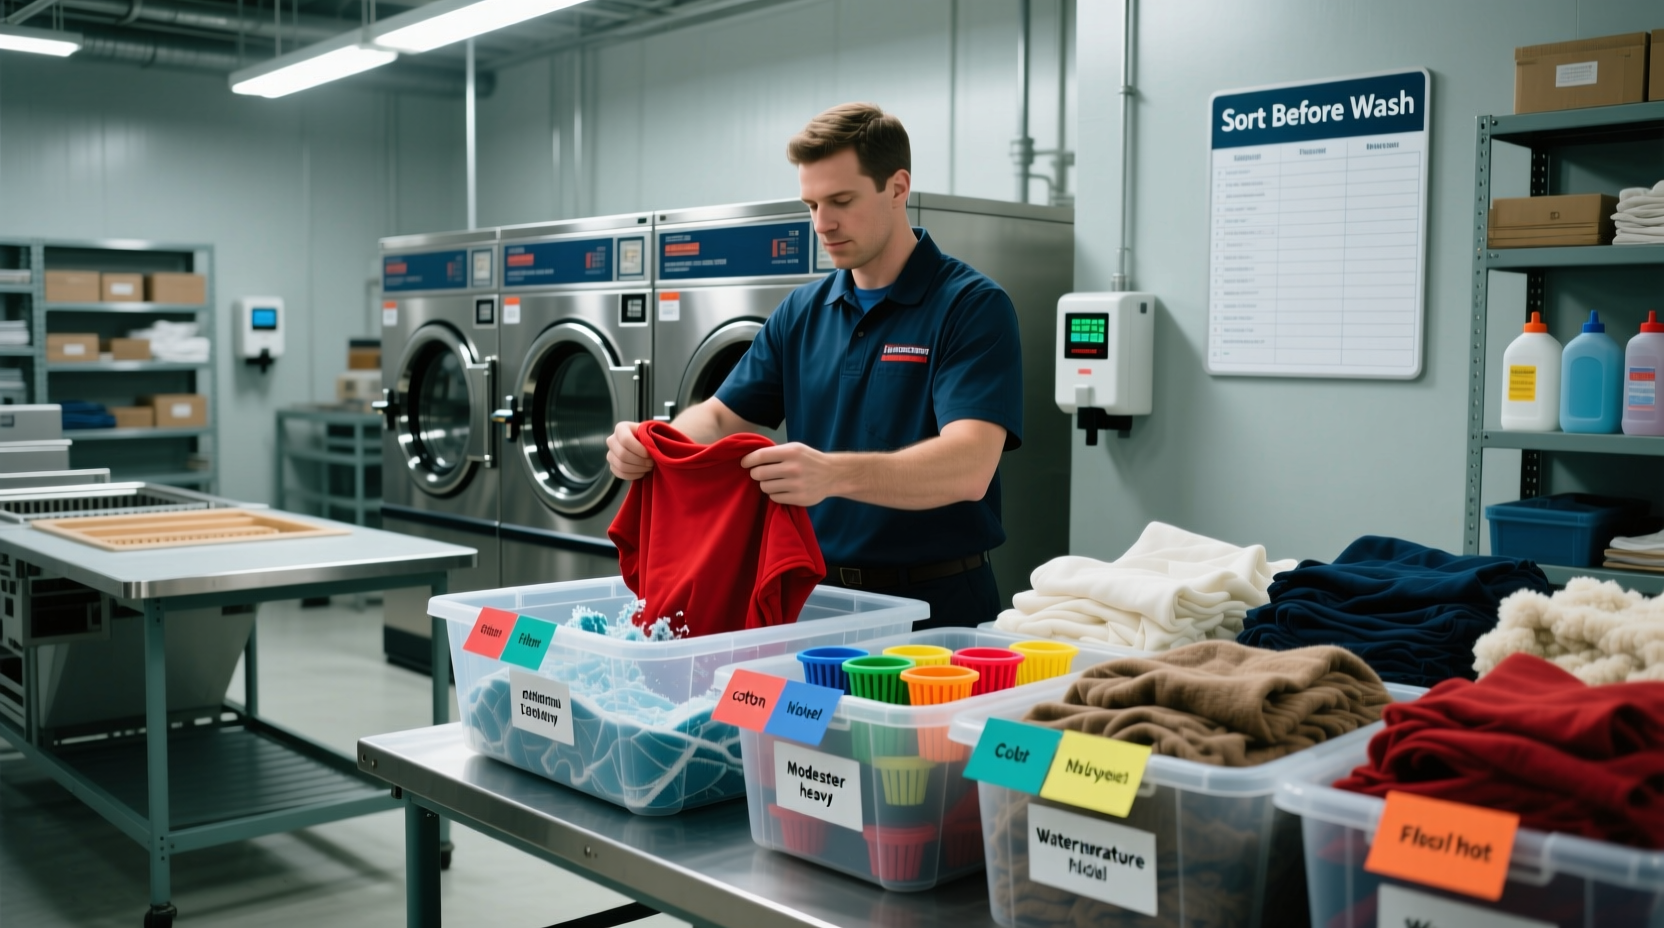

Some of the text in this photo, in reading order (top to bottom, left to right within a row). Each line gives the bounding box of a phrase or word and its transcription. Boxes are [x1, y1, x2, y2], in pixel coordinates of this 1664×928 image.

[1221, 89, 1414, 132] Sort Before Wash
[787, 760, 846, 789] Modester
[799, 781, 833, 808] heavy
[1455, 835, 1492, 863] hot
